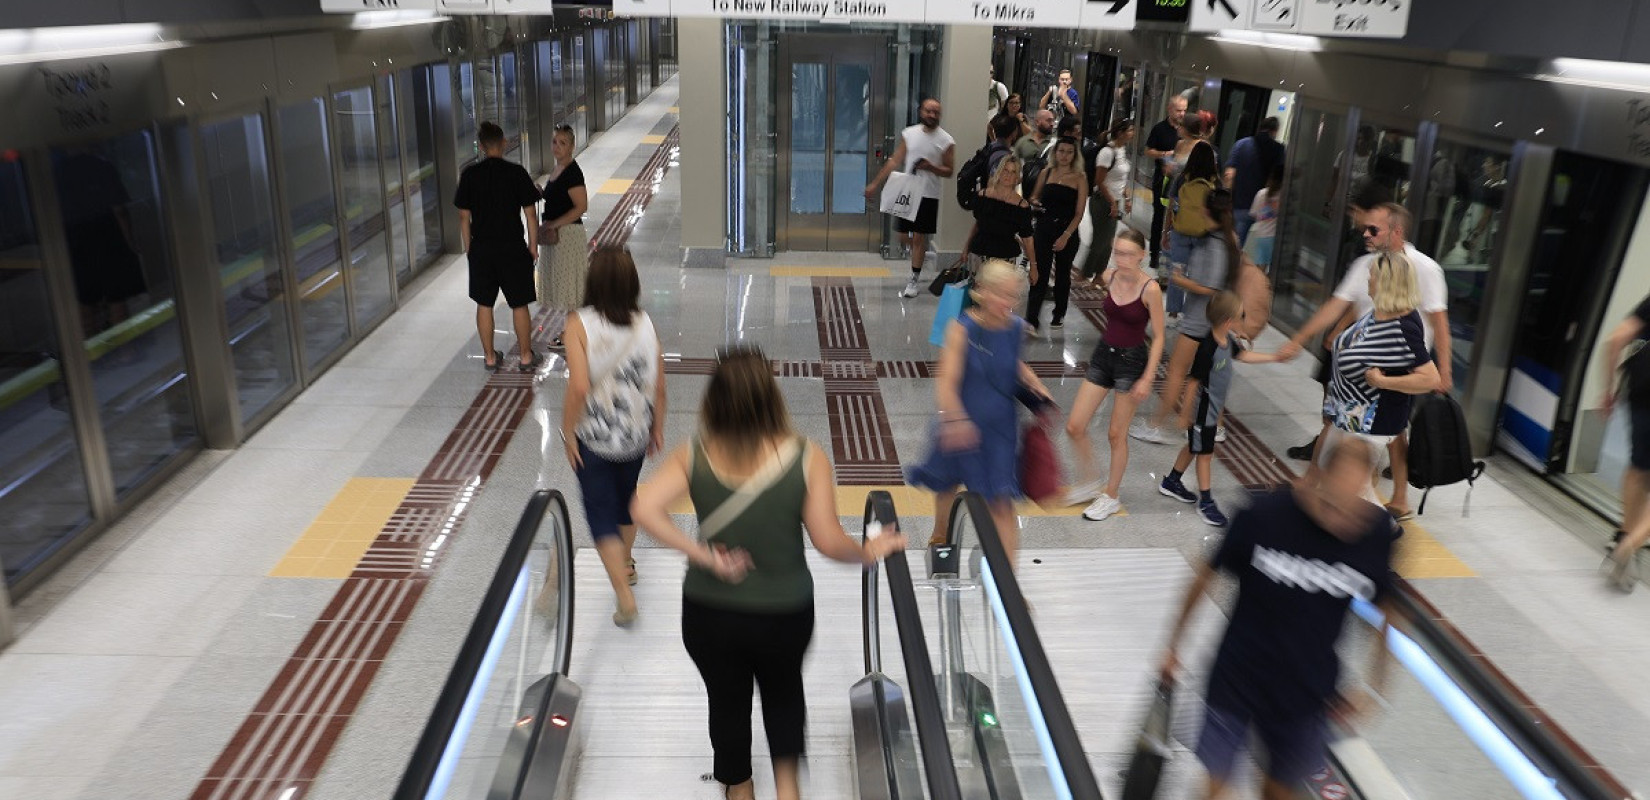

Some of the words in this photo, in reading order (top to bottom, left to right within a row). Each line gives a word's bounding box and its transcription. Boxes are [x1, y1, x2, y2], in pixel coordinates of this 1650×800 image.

[711, 0, 729, 12] To
[734, 0, 766, 12] New
[771, 0, 829, 17] Railway
[834, 1, 887, 16] Station
[972, 2, 990, 19] To
[995, 3, 1035, 20] Mikra
[1333, 14, 1369, 31] Exit
